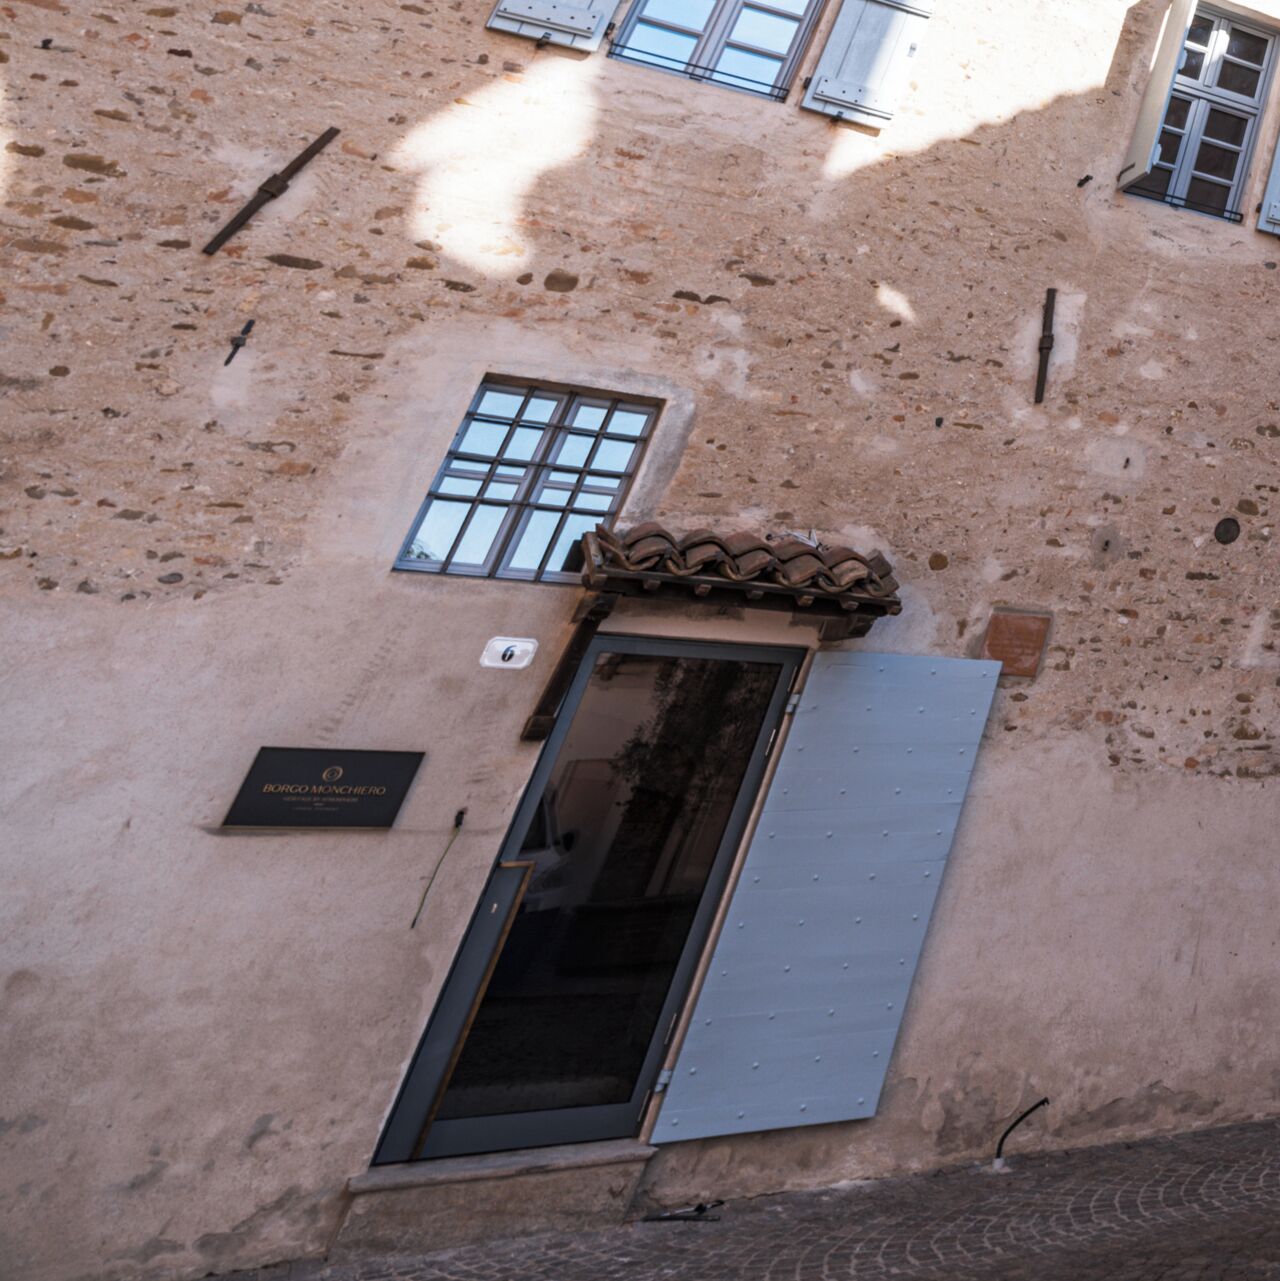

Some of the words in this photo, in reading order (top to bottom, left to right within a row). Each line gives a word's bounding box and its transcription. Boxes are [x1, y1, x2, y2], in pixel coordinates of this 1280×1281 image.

[502, 645, 517, 662] 6
[263, 784, 309, 793] BORGO
[311, 784, 386, 795] MONCHIERO
